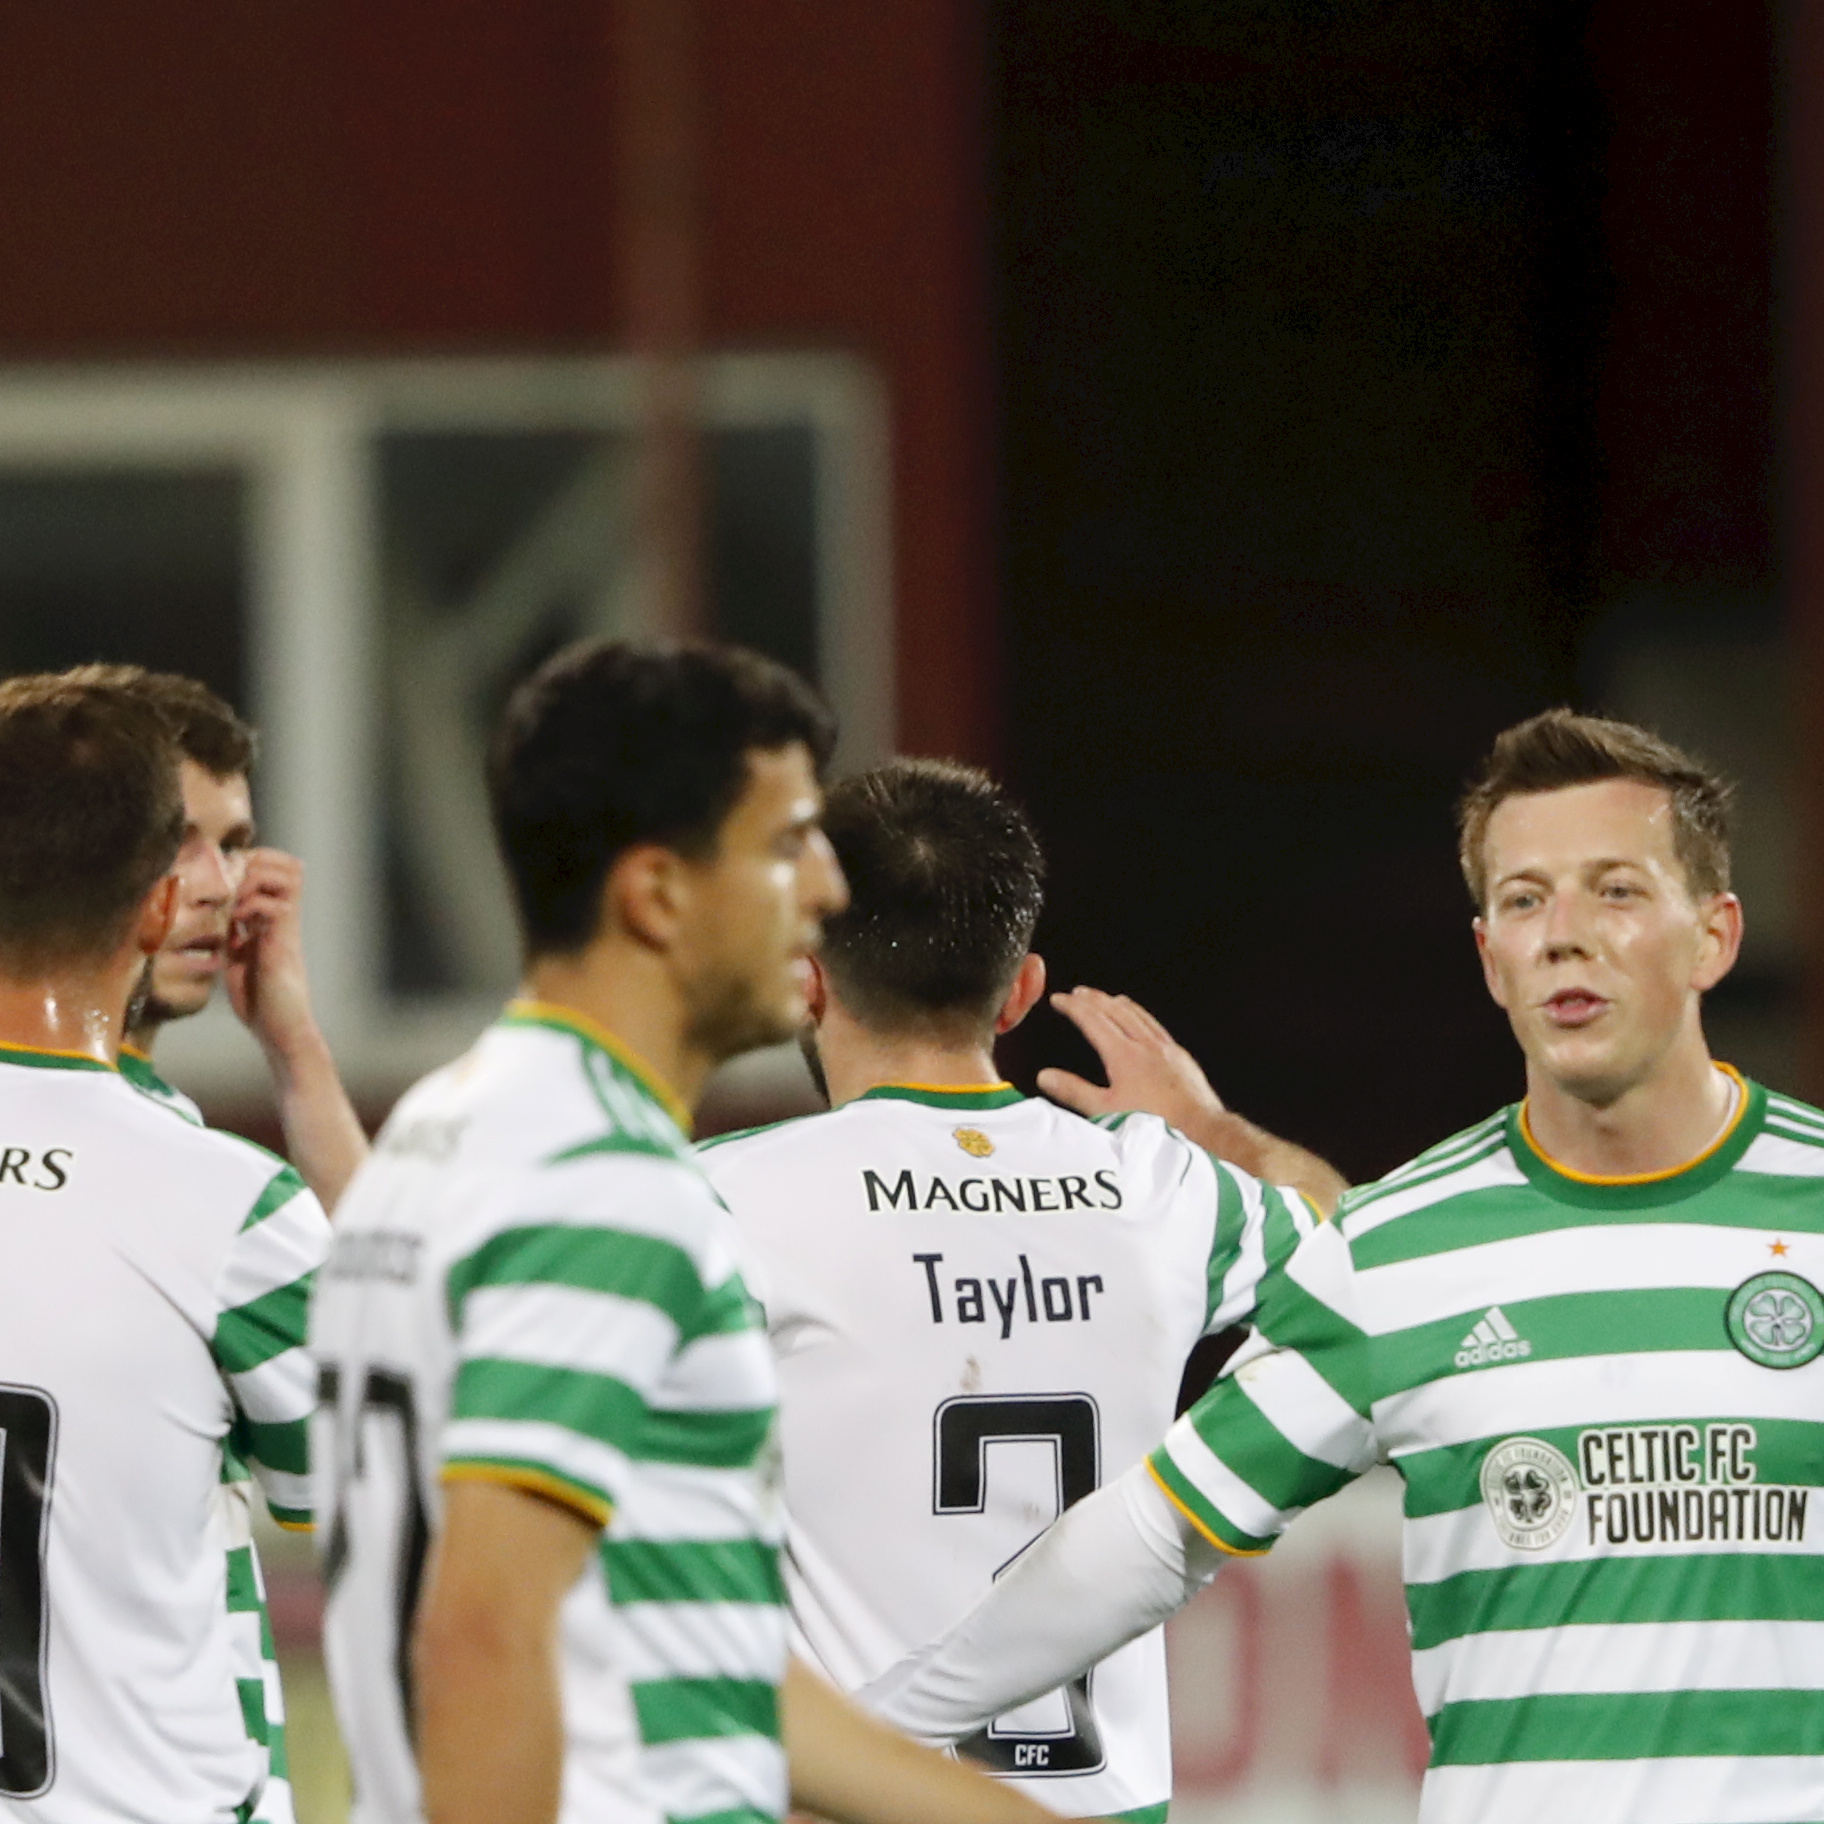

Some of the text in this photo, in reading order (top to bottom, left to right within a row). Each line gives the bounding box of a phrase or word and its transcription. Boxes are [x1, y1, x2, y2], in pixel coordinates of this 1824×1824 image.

[863, 1169, 1123, 1213] MAGNERS
[912, 1252, 1105, 1340] Taylor
[1454, 1338, 1532, 1369] adidas
[1582, 1426, 1756, 1486] CELTIC FC
[1586, 1489, 1809, 1546] FOUNDATION
[1014, 1743, 1050, 1767] CFC
